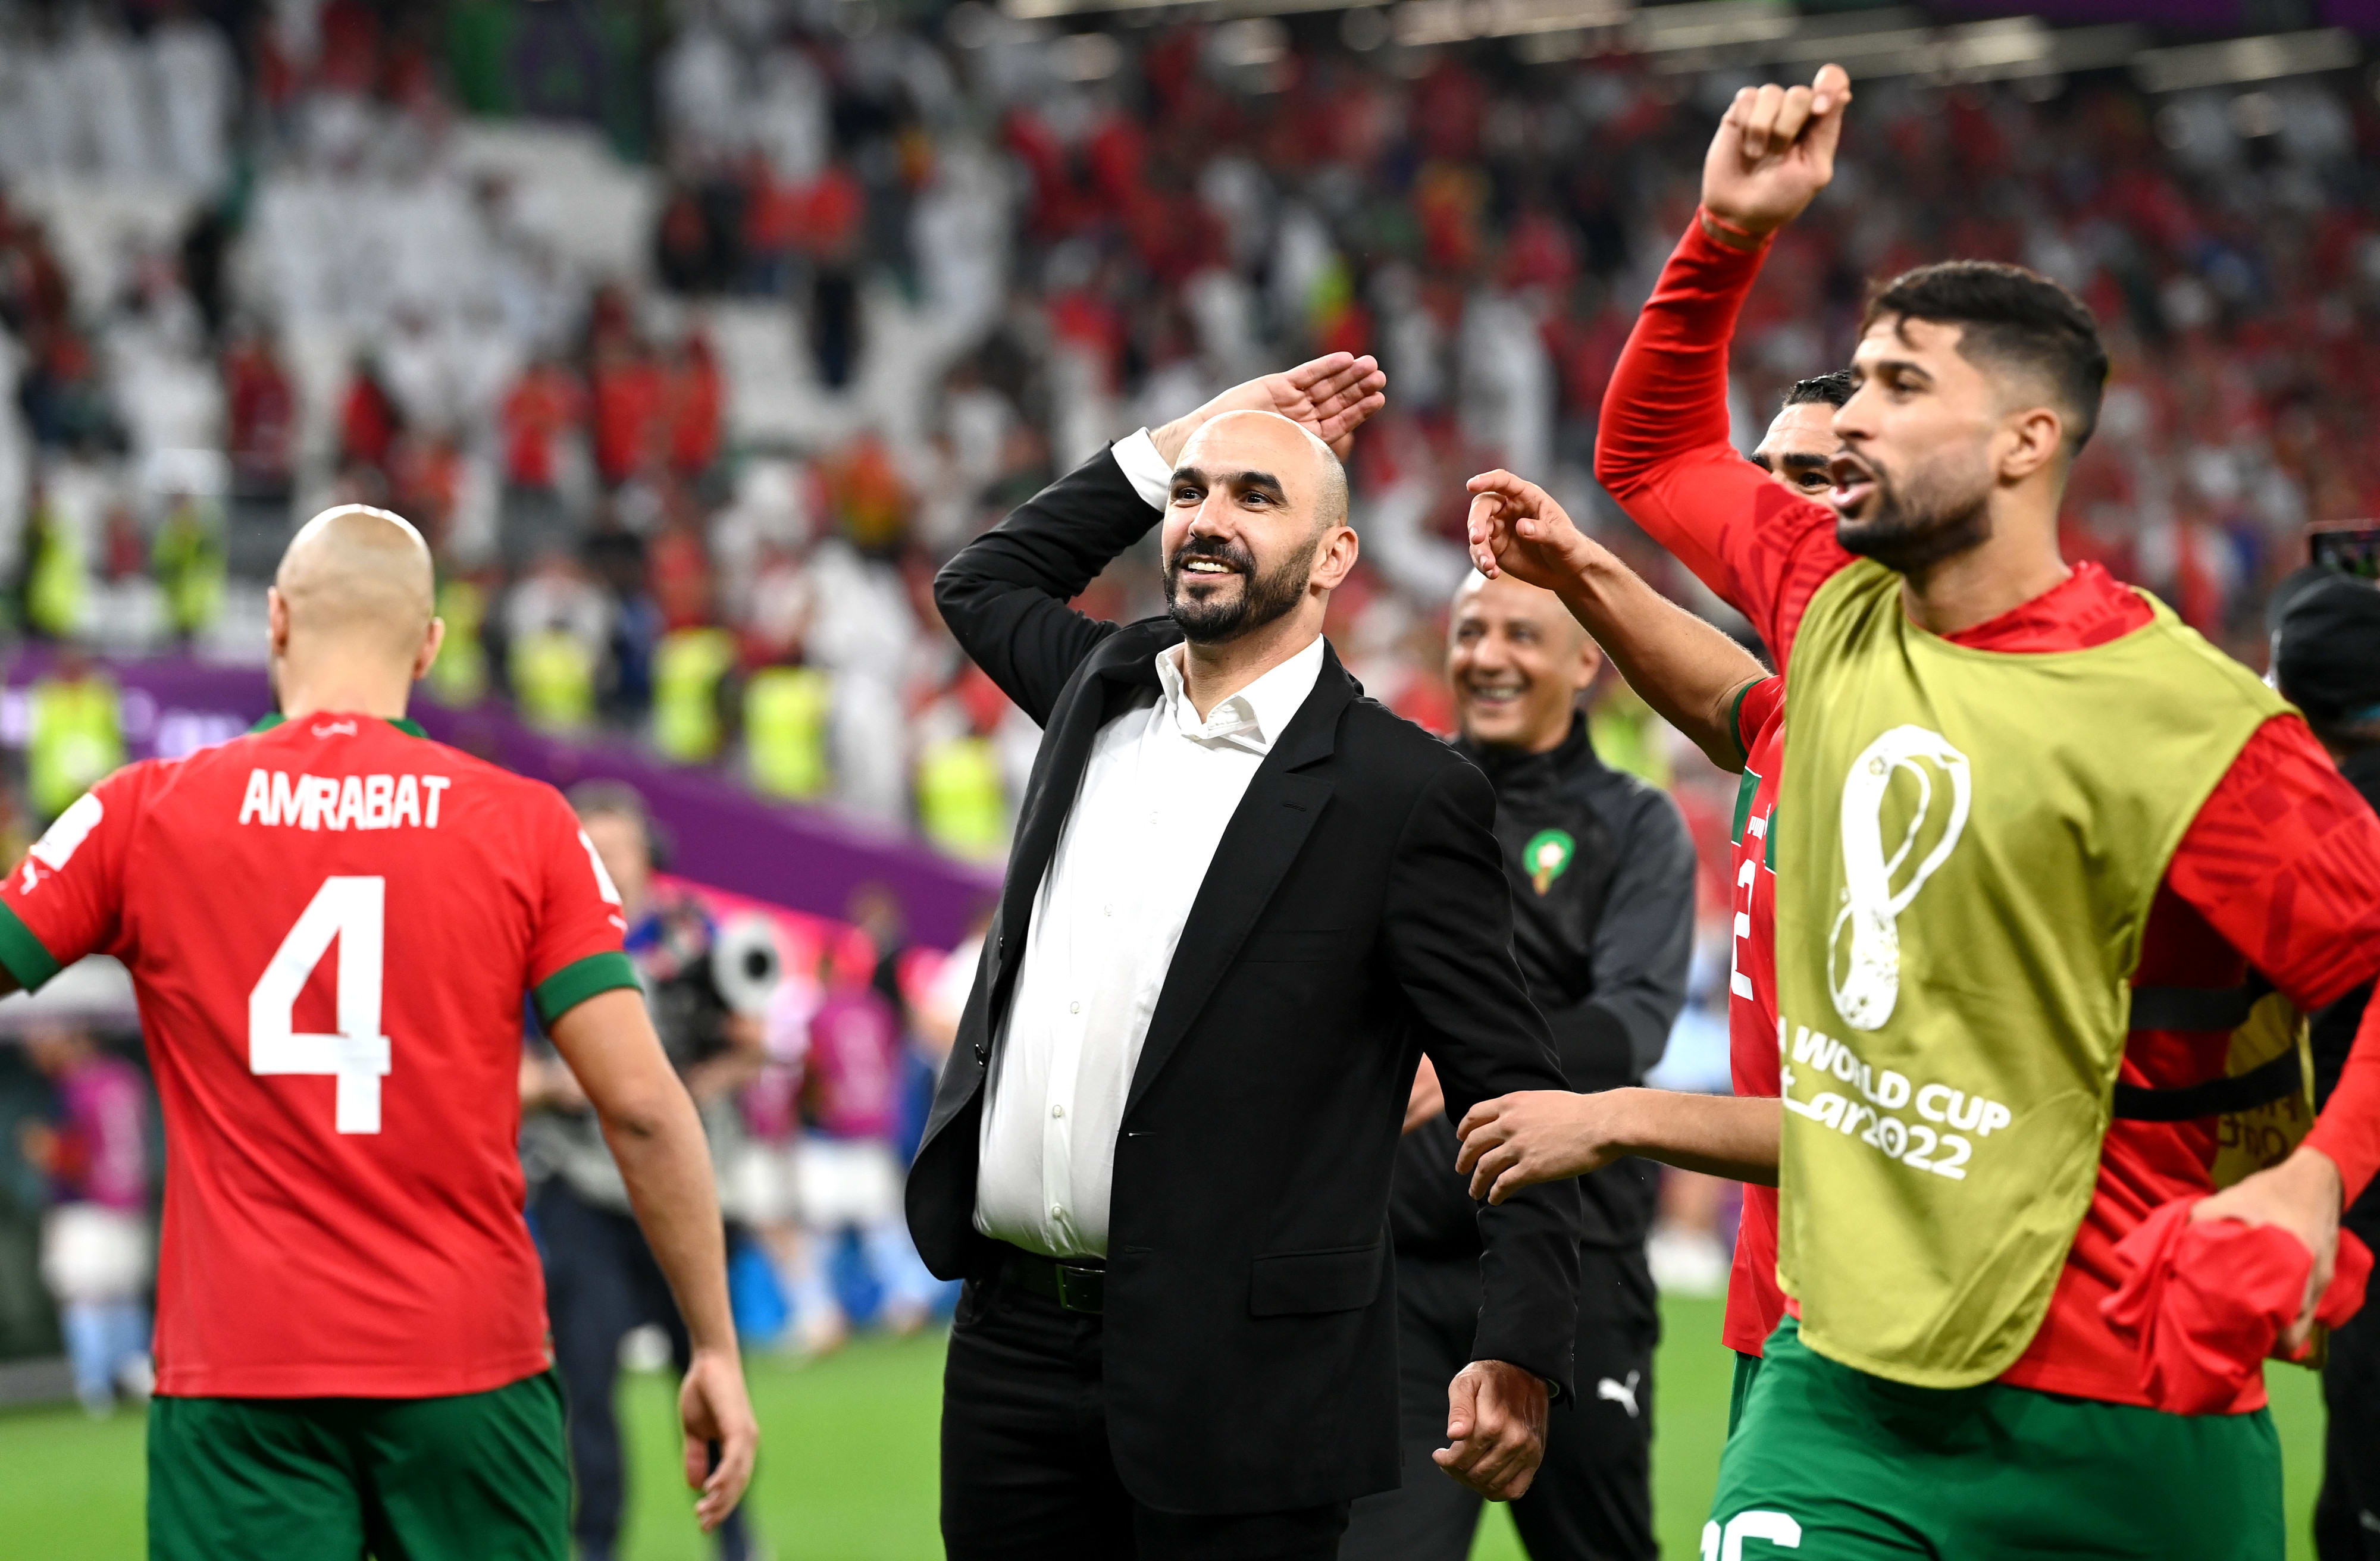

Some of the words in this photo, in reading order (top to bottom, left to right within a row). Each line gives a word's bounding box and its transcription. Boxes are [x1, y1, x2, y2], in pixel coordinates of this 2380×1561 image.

[239, 767, 451, 832] AMRABAT
[249, 875, 392, 1134] 4
[1916, 1083, 2011, 1137] CUP
